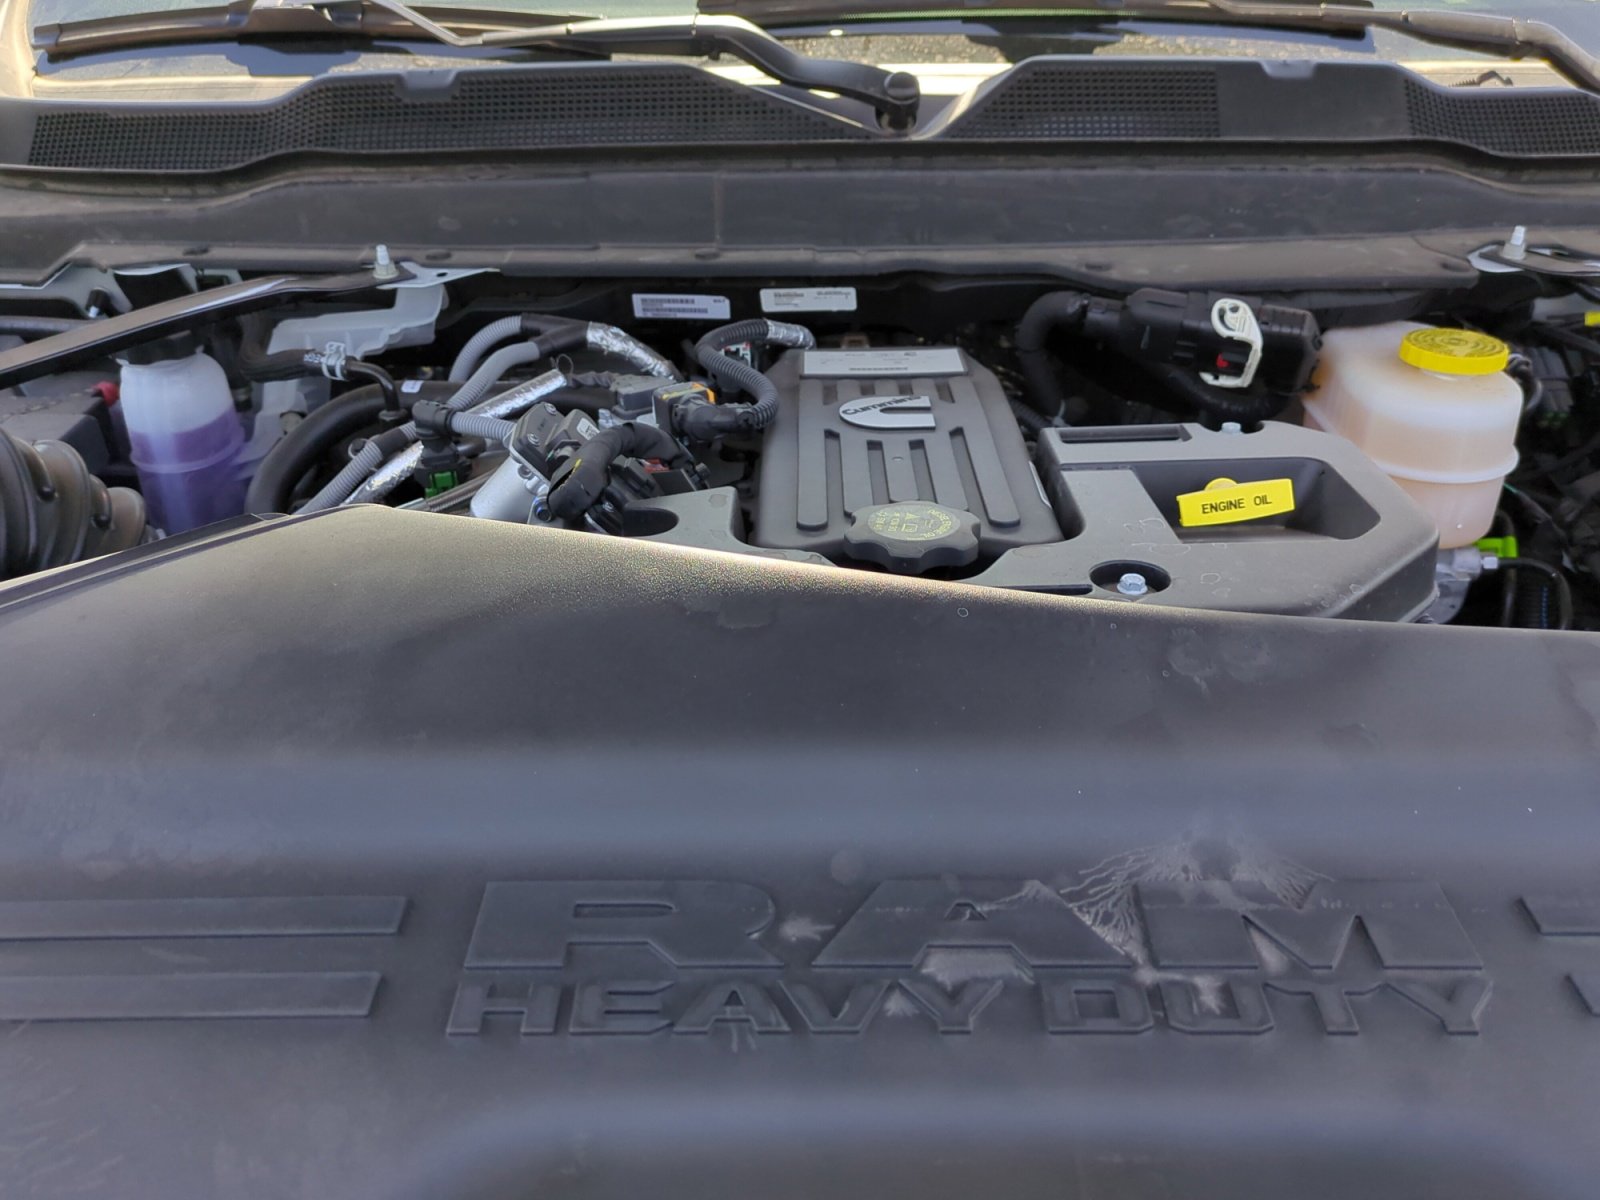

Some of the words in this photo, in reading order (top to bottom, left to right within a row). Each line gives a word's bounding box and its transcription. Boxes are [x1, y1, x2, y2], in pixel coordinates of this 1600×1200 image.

[841, 395, 922, 416] Cummins
[1201, 498, 1246, 514] ENGINE
[1253, 494, 1272, 506] OIL
[463, 880, 1484, 969] RAM
[446, 979, 1003, 1036] HEAVY
[1040, 977, 1494, 1036] DUTY
